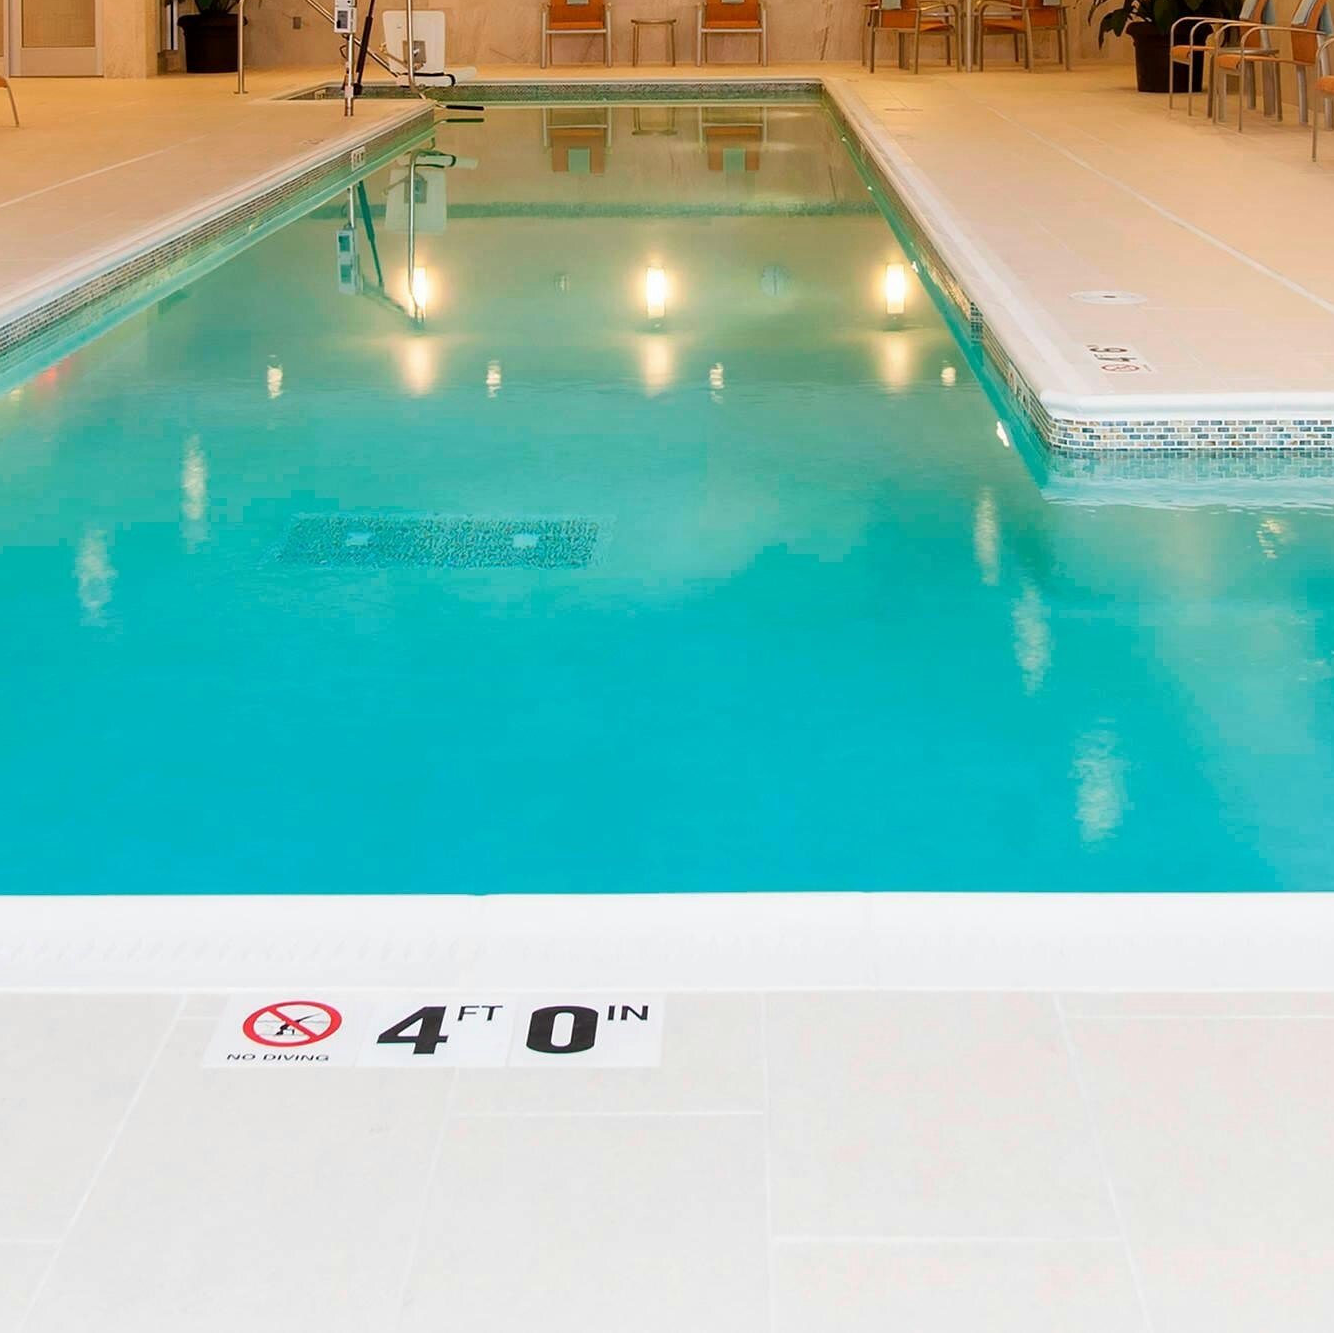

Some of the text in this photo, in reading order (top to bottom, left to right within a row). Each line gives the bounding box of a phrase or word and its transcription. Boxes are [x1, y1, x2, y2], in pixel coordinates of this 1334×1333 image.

[376, 1005, 649, 1055] 4 FT 0 IN
[227, 1053, 329, 1062] NO DIVING
